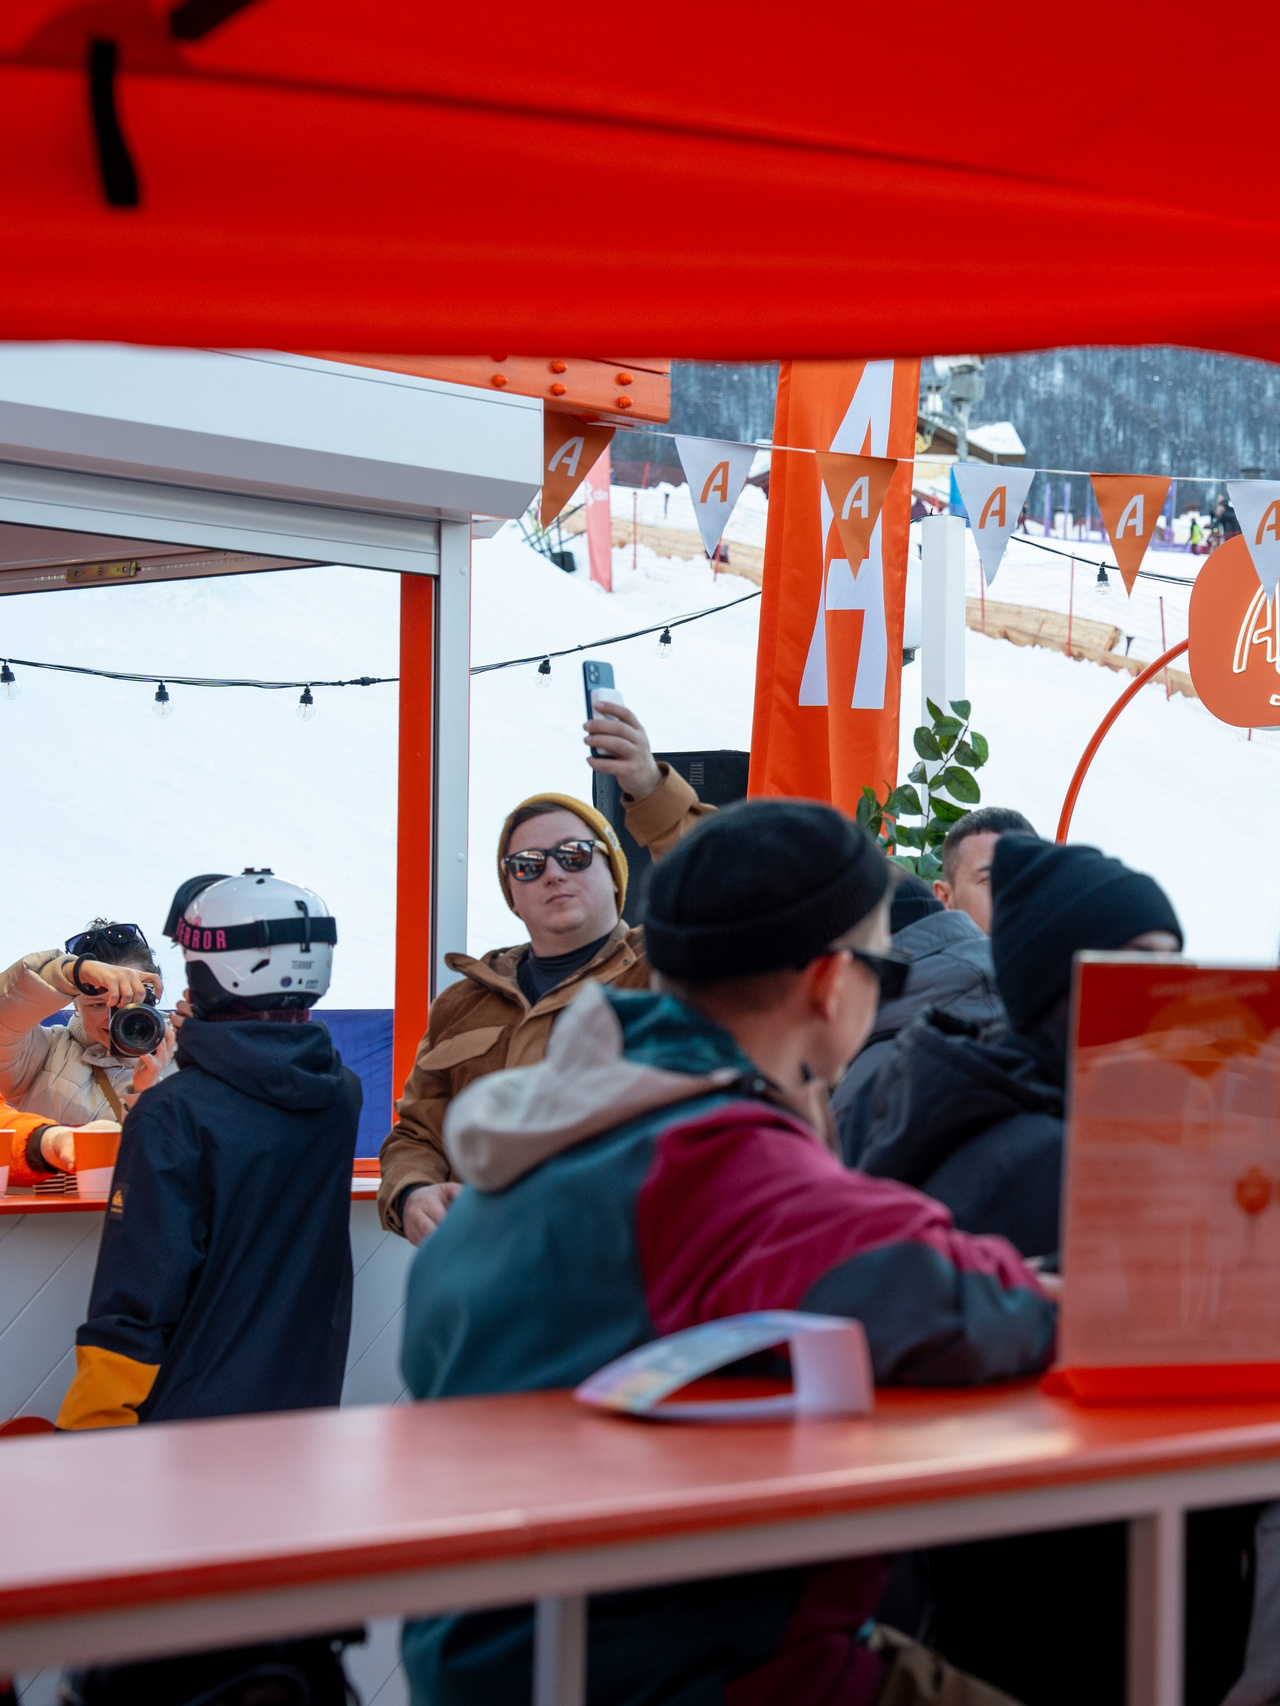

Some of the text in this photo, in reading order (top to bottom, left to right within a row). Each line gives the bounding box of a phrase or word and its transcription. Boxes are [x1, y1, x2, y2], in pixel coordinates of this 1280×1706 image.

[547, 436, 585, 477] A
[700, 461, 730, 504] A
[841, 476, 870, 520] A
[978, 486, 1007, 530] A
[1115, 494, 1144, 540] A
